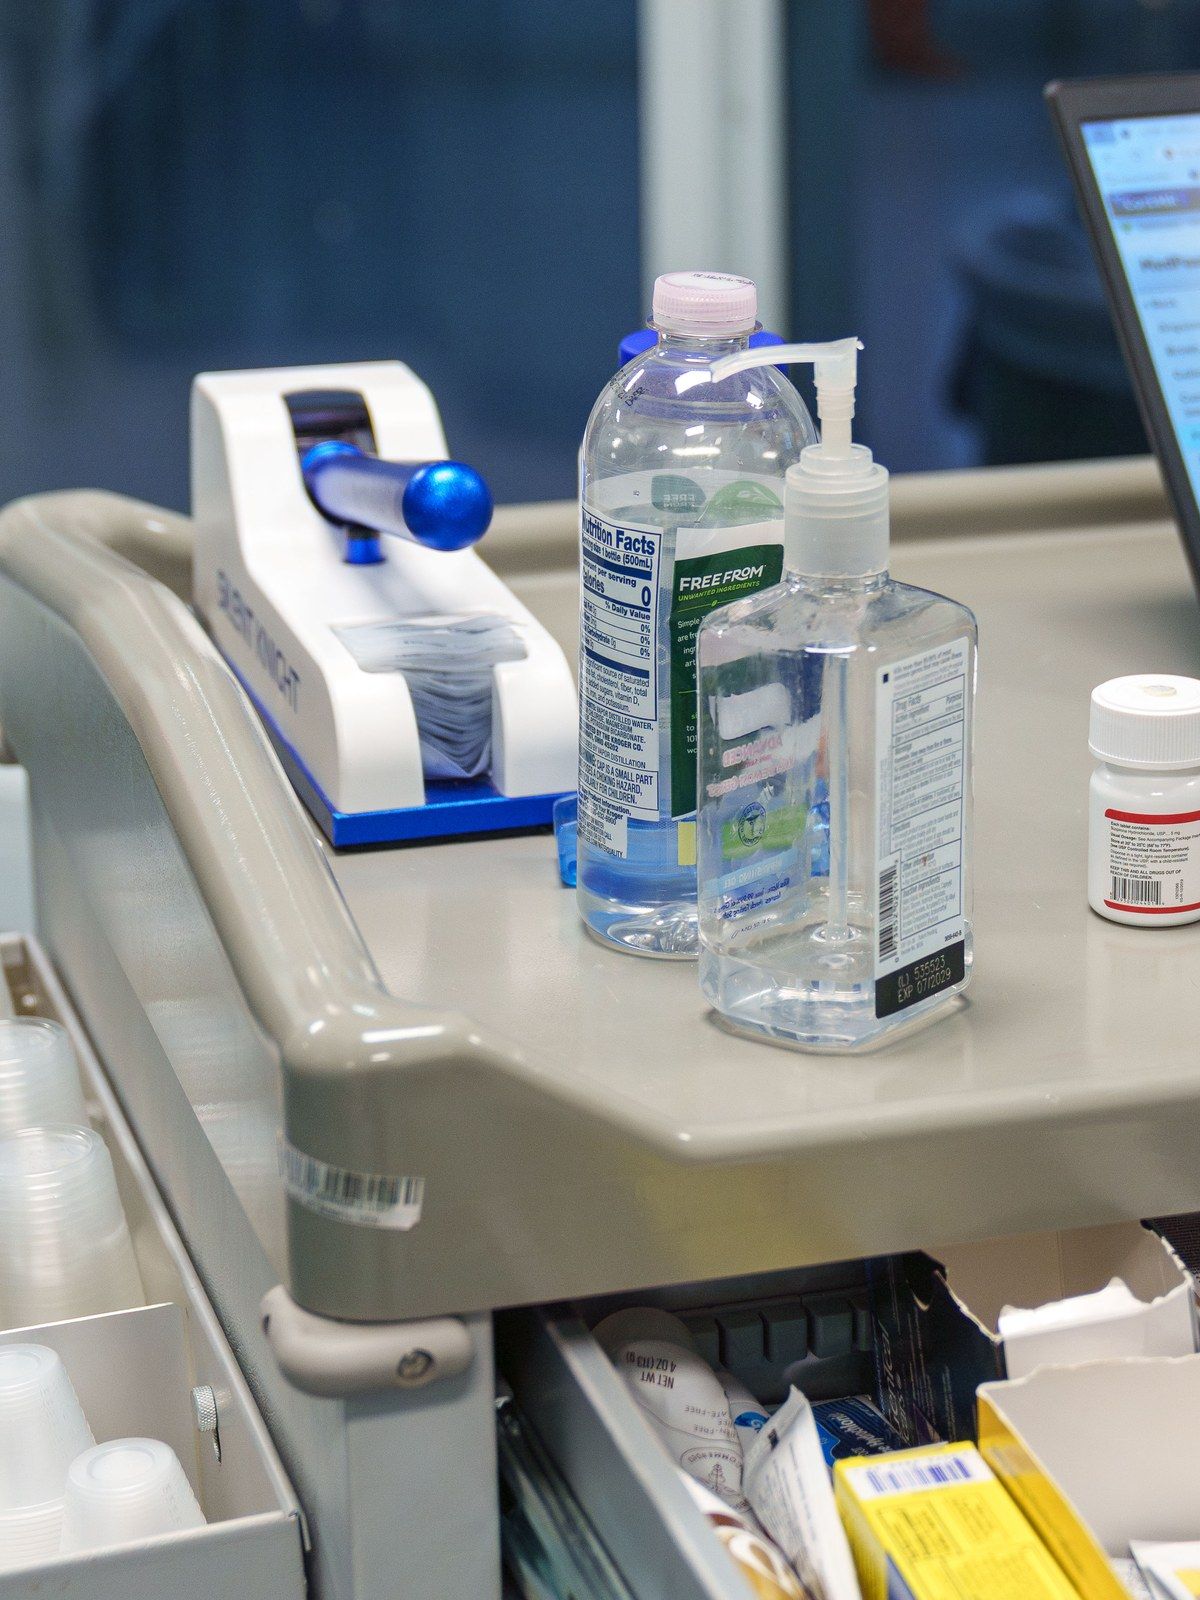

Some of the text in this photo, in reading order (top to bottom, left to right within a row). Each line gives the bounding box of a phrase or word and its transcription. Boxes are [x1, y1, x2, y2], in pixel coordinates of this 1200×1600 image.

[616, 529, 655, 555] Facts
[605, 549, 621, 562] bottle
[623, 554, 653, 570] (500mL)
[583, 559, 637, 588] mount per serving
[680, 565, 764, 591] FREE FROM
[641, 586, 651, 606] 0
[678, 581, 760, 601] UNWANTED INGREDIENTS
[611, 604, 628, 616] Daily
[629, 609, 651, 621] Value
[640, 624, 651, 634] 0%
[678, 619, 699, 628] Simple
[640, 636, 651, 646] 0%
[678, 634, 688, 642] are
[639, 647, 651, 658] 0%
[683, 646, 696, 654] ingr
[603, 667, 617, 678] source
[624, 675, 649, 687] saturated
[635, 687, 647, 698] total
[609, 708, 631, 727] DISTILLED
[632, 722, 654, 731] WATER,
[602, 730, 643, 752] THE KROGER CO.
[611, 752, 646, 769] DISTILLATION
[615, 767, 633, 783] SMALL
[636, 774, 654, 786] PART
[599, 784, 637, 804] FOR CHILDREN.
[617, 779, 643, 796] HAZARD,
[601, 799, 631, 816] Information,
[607, 808, 623, 820] Kroger
[914, 955, 946, 980] 535523
[898, 968, 952, 1003] EXP 07/2029
[656, 1358, 668, 1371] OZ
[671, 1361, 677, 1373] 4
[640, 1371, 674, 1389] NET WT
